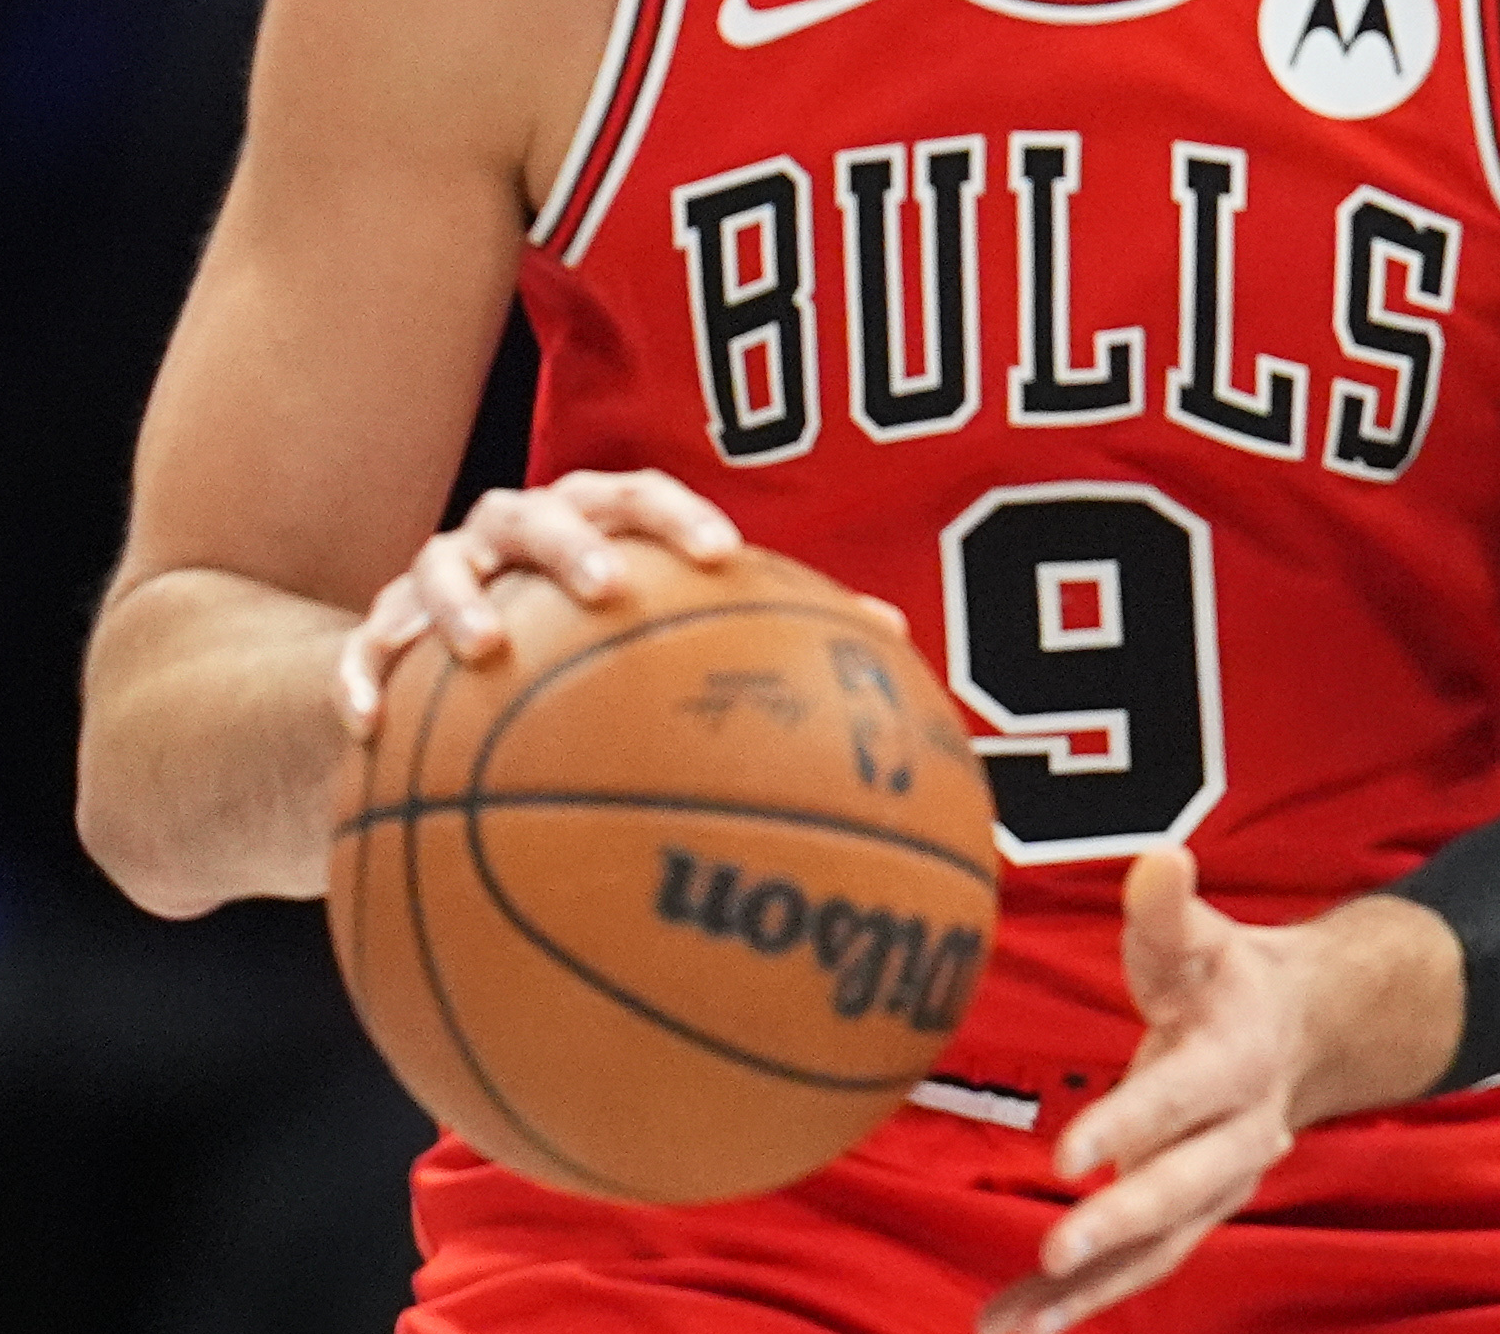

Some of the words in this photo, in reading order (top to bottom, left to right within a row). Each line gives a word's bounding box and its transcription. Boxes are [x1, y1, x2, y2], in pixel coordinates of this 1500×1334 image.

[671, 130, 1463, 483] BULLS
[939, 481, 1227, 866] 9
[653, 843, 984, 1035] Wilson
